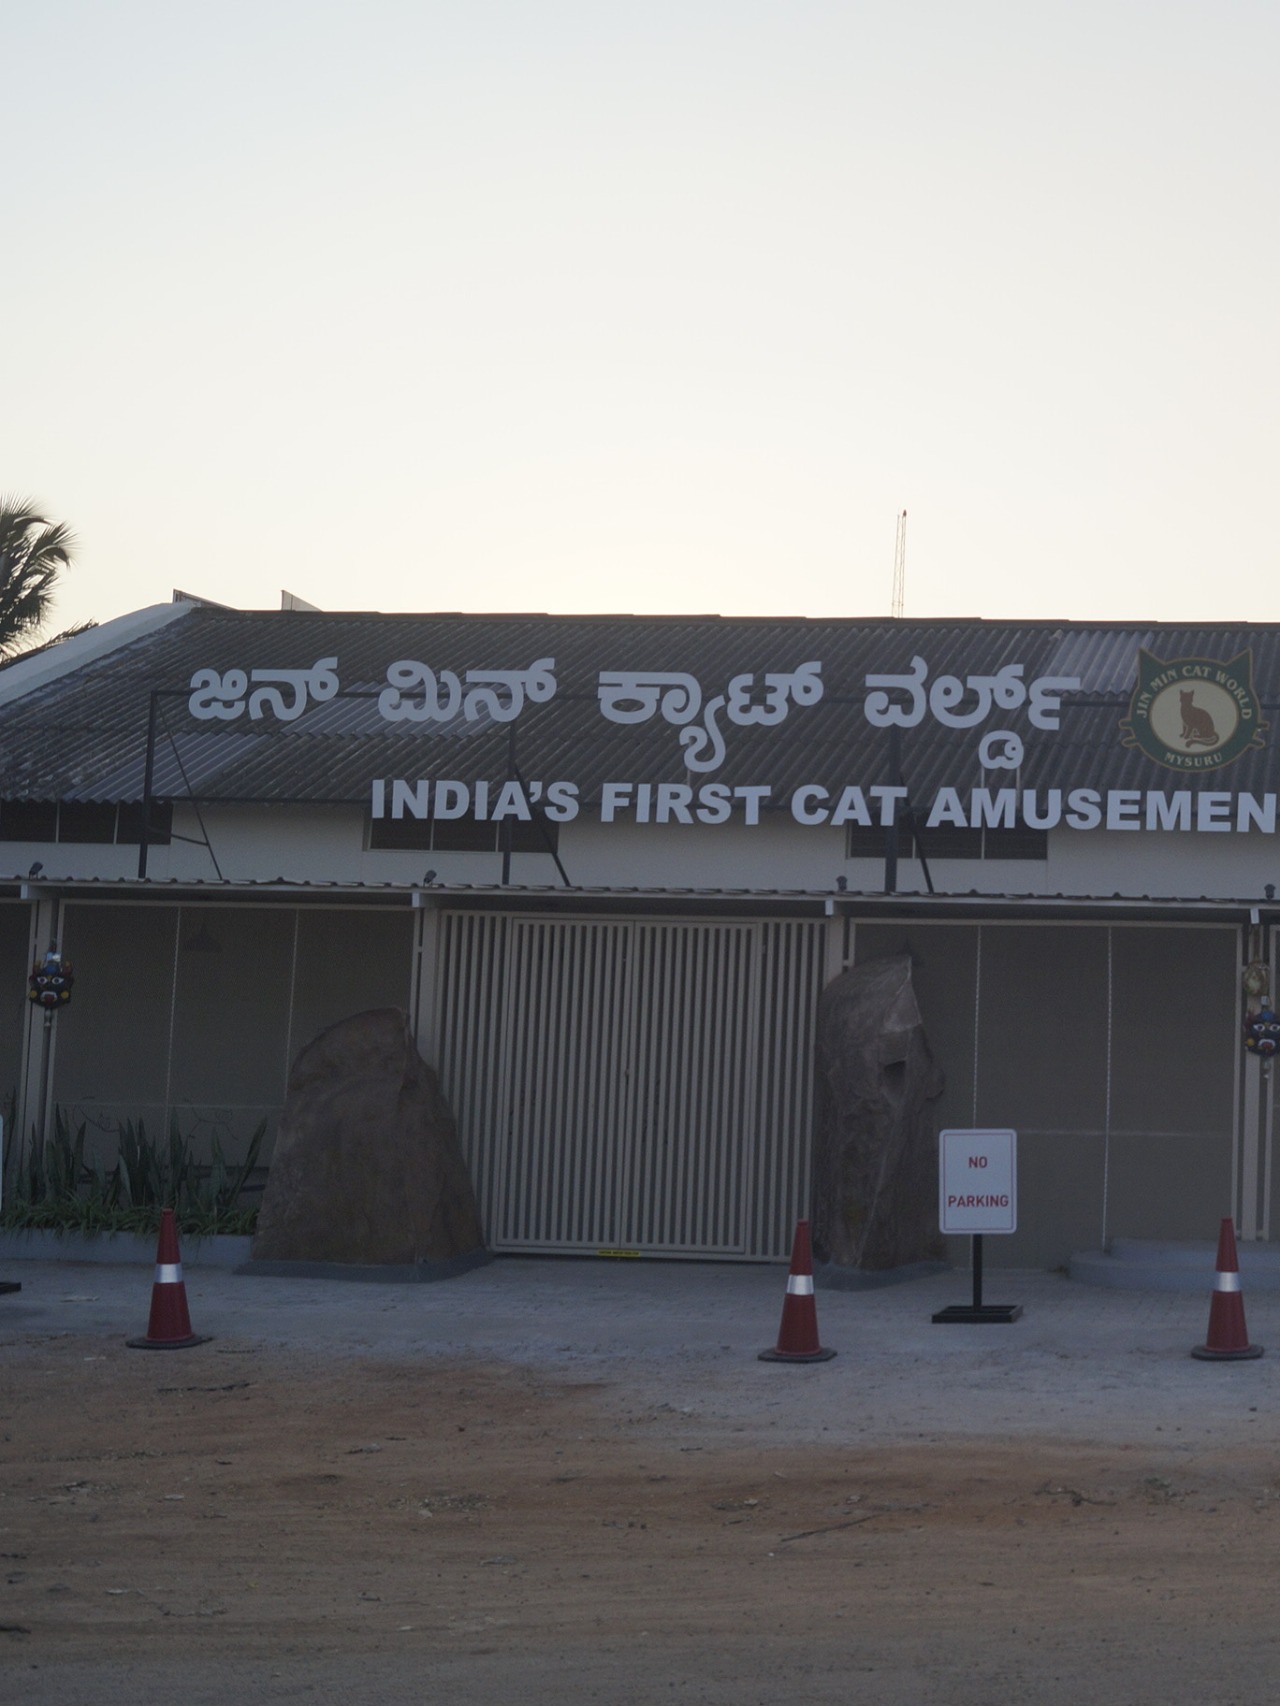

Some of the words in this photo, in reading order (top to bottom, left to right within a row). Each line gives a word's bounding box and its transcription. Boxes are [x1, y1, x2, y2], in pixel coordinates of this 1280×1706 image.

[1136, 691, 1152, 718] JIN
[1150, 668, 1178, 692] MIN
[1182, 665, 1212, 677] CAT
[1215, 670, 1252, 719] WORLD
[188, 656, 340, 721] ಜಿನ್
[378, 657, 557, 723] ಮಿನ್
[597, 660, 824, 773] ಕ್ಯಾಟ್
[1164, 752, 1223, 767] MYSURU
[371, 779, 579, 822] INDIA'S
[600, 782, 771, 825] FIRST
[791, 785, 907, 827] CAT
[968, 1156, 988, 1168] NO
[947, 1195, 1009, 1207] PARKING
